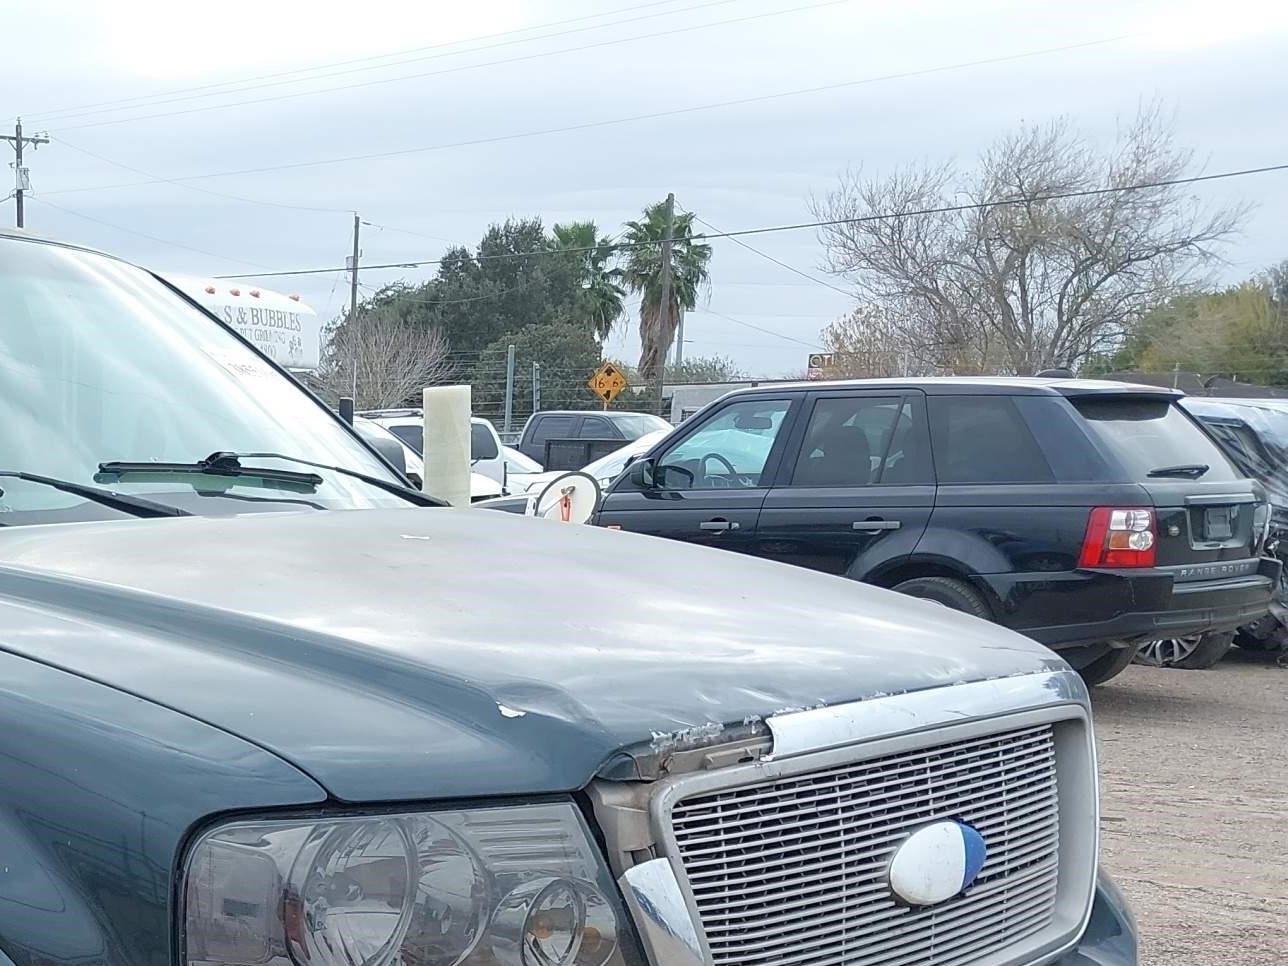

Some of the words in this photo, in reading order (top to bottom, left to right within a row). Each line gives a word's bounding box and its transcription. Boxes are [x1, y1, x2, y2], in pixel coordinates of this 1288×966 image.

[237, 306, 247, 325] &
[250, 306, 302, 332] BUBBLES
[1180, 566, 1217, 578] RANGE
